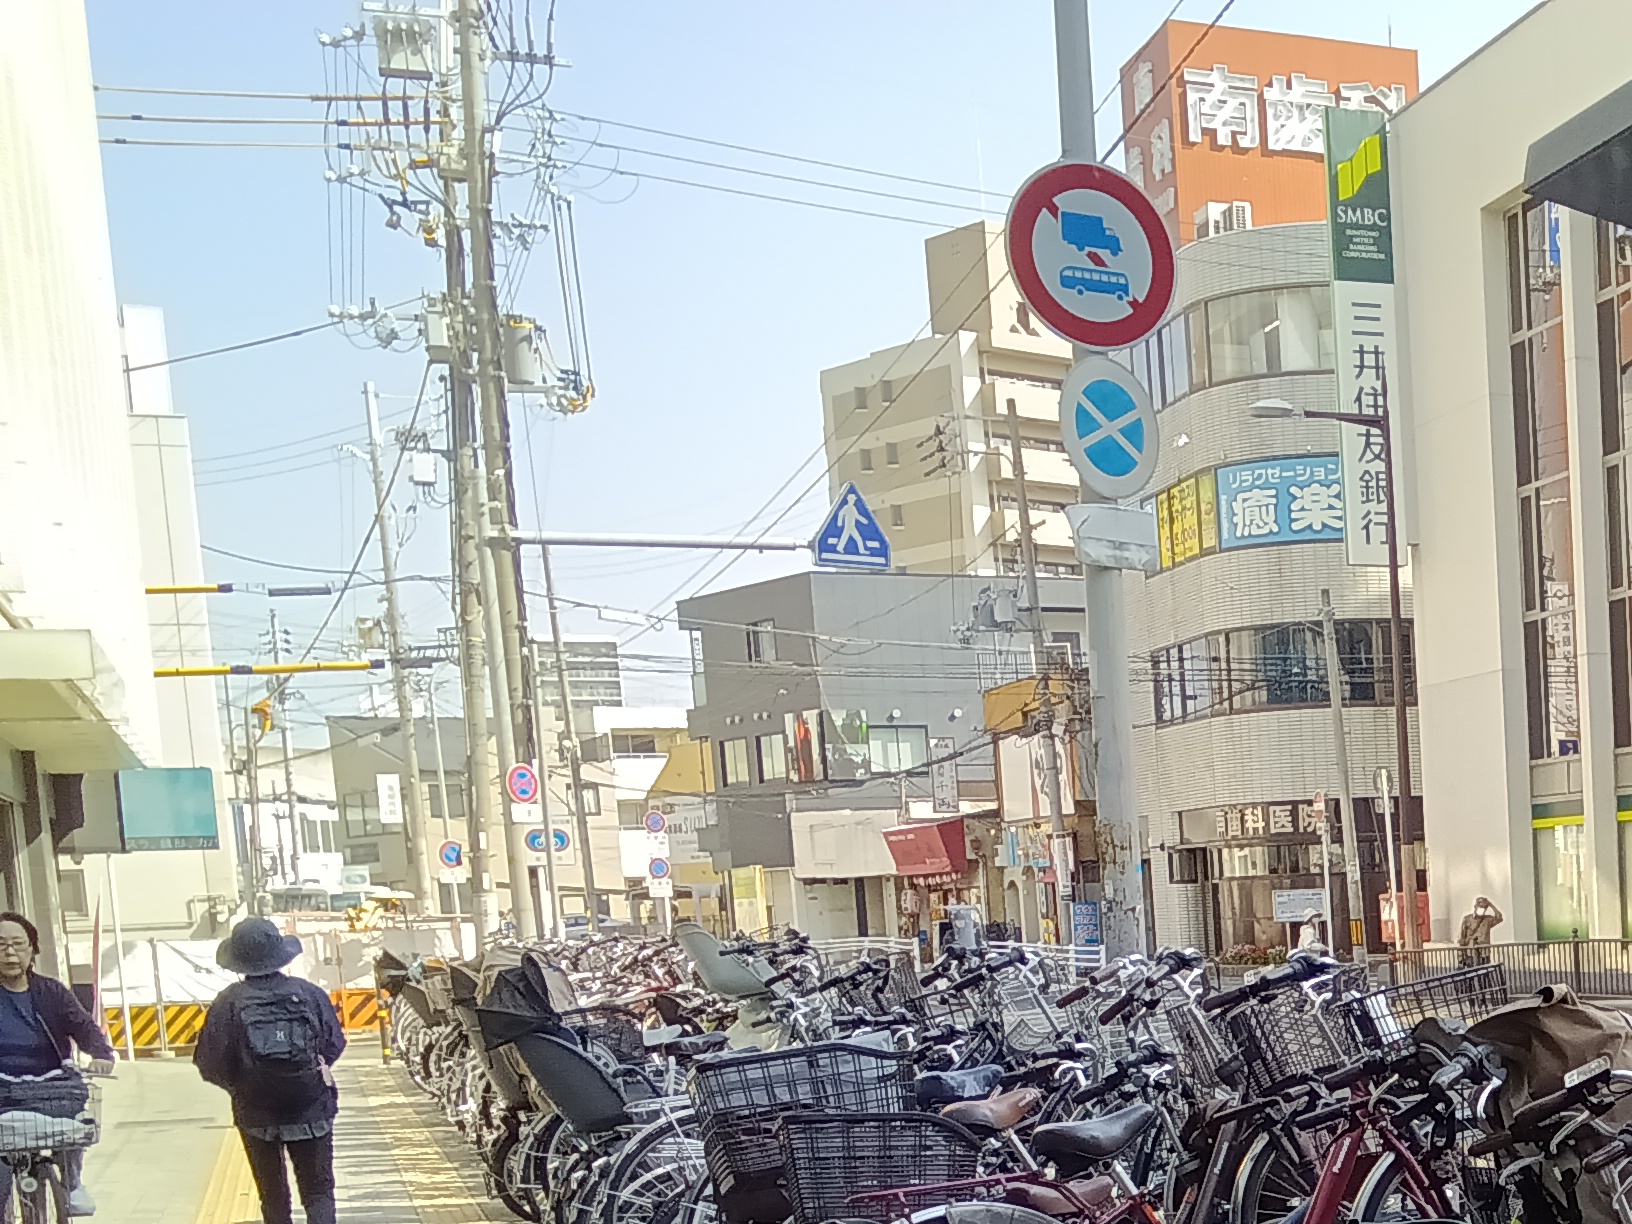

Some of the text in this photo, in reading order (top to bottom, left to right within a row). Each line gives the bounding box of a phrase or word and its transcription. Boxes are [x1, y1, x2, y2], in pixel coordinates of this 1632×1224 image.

[1337, 206, 1388, 227] SMBC
[1351, 301, 1392, 546] 三井住友銀行
[1229, 464, 1342, 488] リラクゼーション
[1232, 483, 1344, 538] 癒楽
